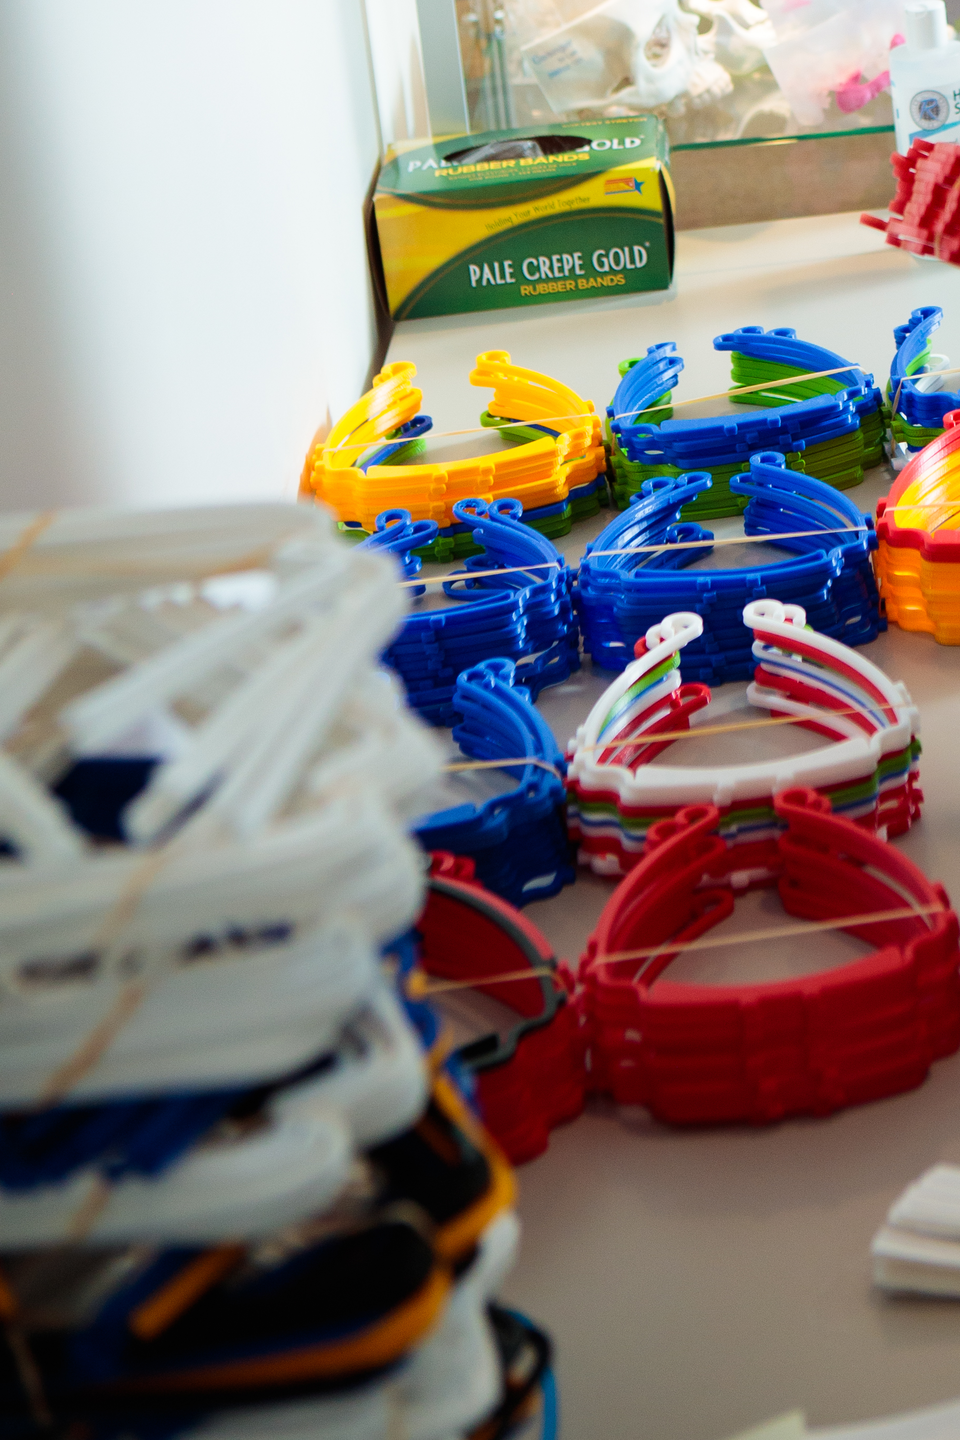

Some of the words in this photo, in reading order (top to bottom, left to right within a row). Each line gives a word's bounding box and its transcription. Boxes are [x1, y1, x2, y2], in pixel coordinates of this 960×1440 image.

[407, 157, 460, 173] PAL
[434, 160, 516, 177] RUBBER
[519, 152, 590, 166] BANDS
[484, 215, 514, 232] Holding
[512, 209, 531, 220] Your
[532, 201, 556, 214] World
[556, 196, 591, 210] Together
[468, 259, 516, 288] PALE
[522, 251, 586, 281] CREPE
[592, 244, 648, 273] GOLD
[520, 279, 576, 297] RUBBER
[577, 274, 626, 290] BANDS
